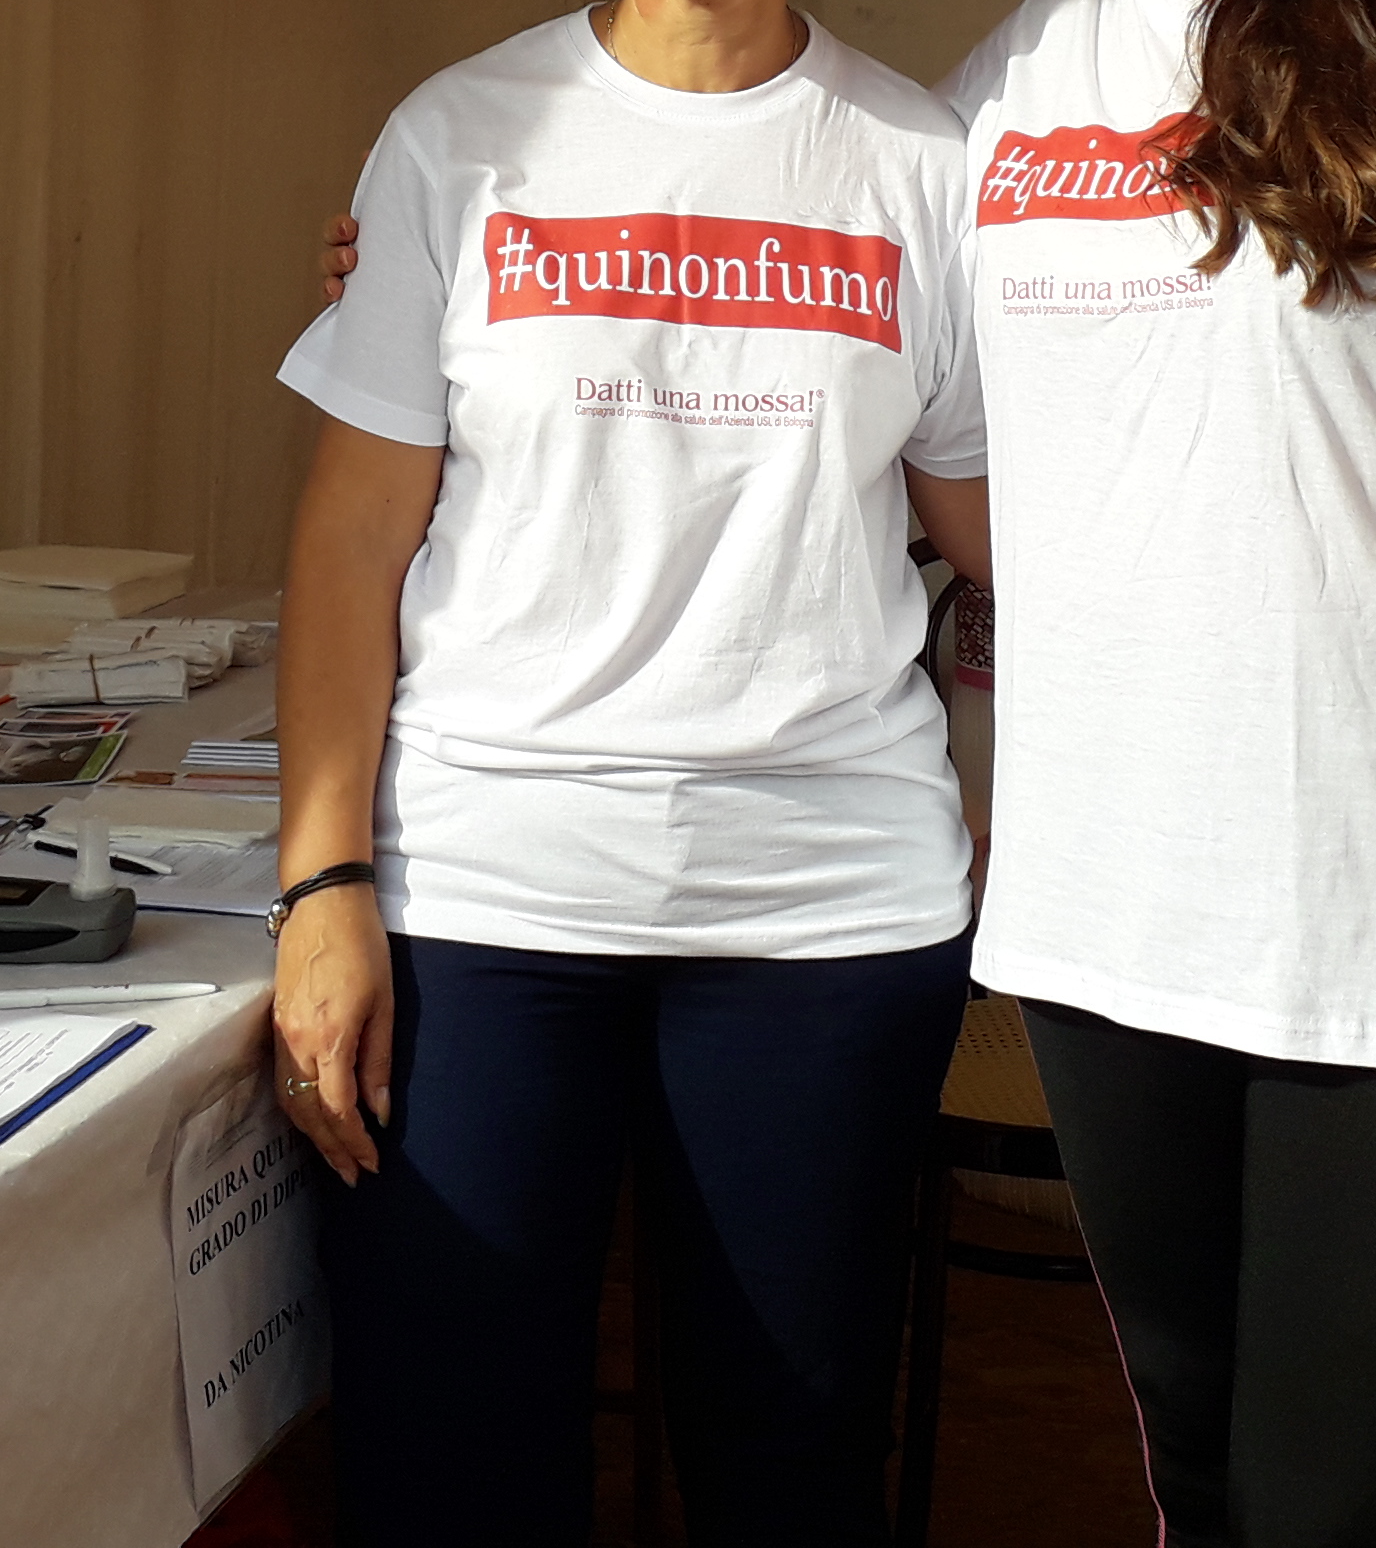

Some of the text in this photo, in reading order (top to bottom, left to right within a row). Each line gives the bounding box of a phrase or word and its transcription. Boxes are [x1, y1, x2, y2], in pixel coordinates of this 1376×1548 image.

[983, 138, 1177, 215] #quino
[497, 227, 892, 321] #quinonfumo
[1002, 275, 1054, 300] Datti
[1064, 281, 1112, 300] una
[575, 377, 642, 402] Datti
[653, 388, 701, 410] una
[186, 1165, 249, 1233] MISURA
[253, 1137, 284, 1179] QUI
[188, 1211, 247, 1277] GRADO
[251, 1195, 269, 1228] DI
[204, 1299, 306, 1410] DA NICOTINA
